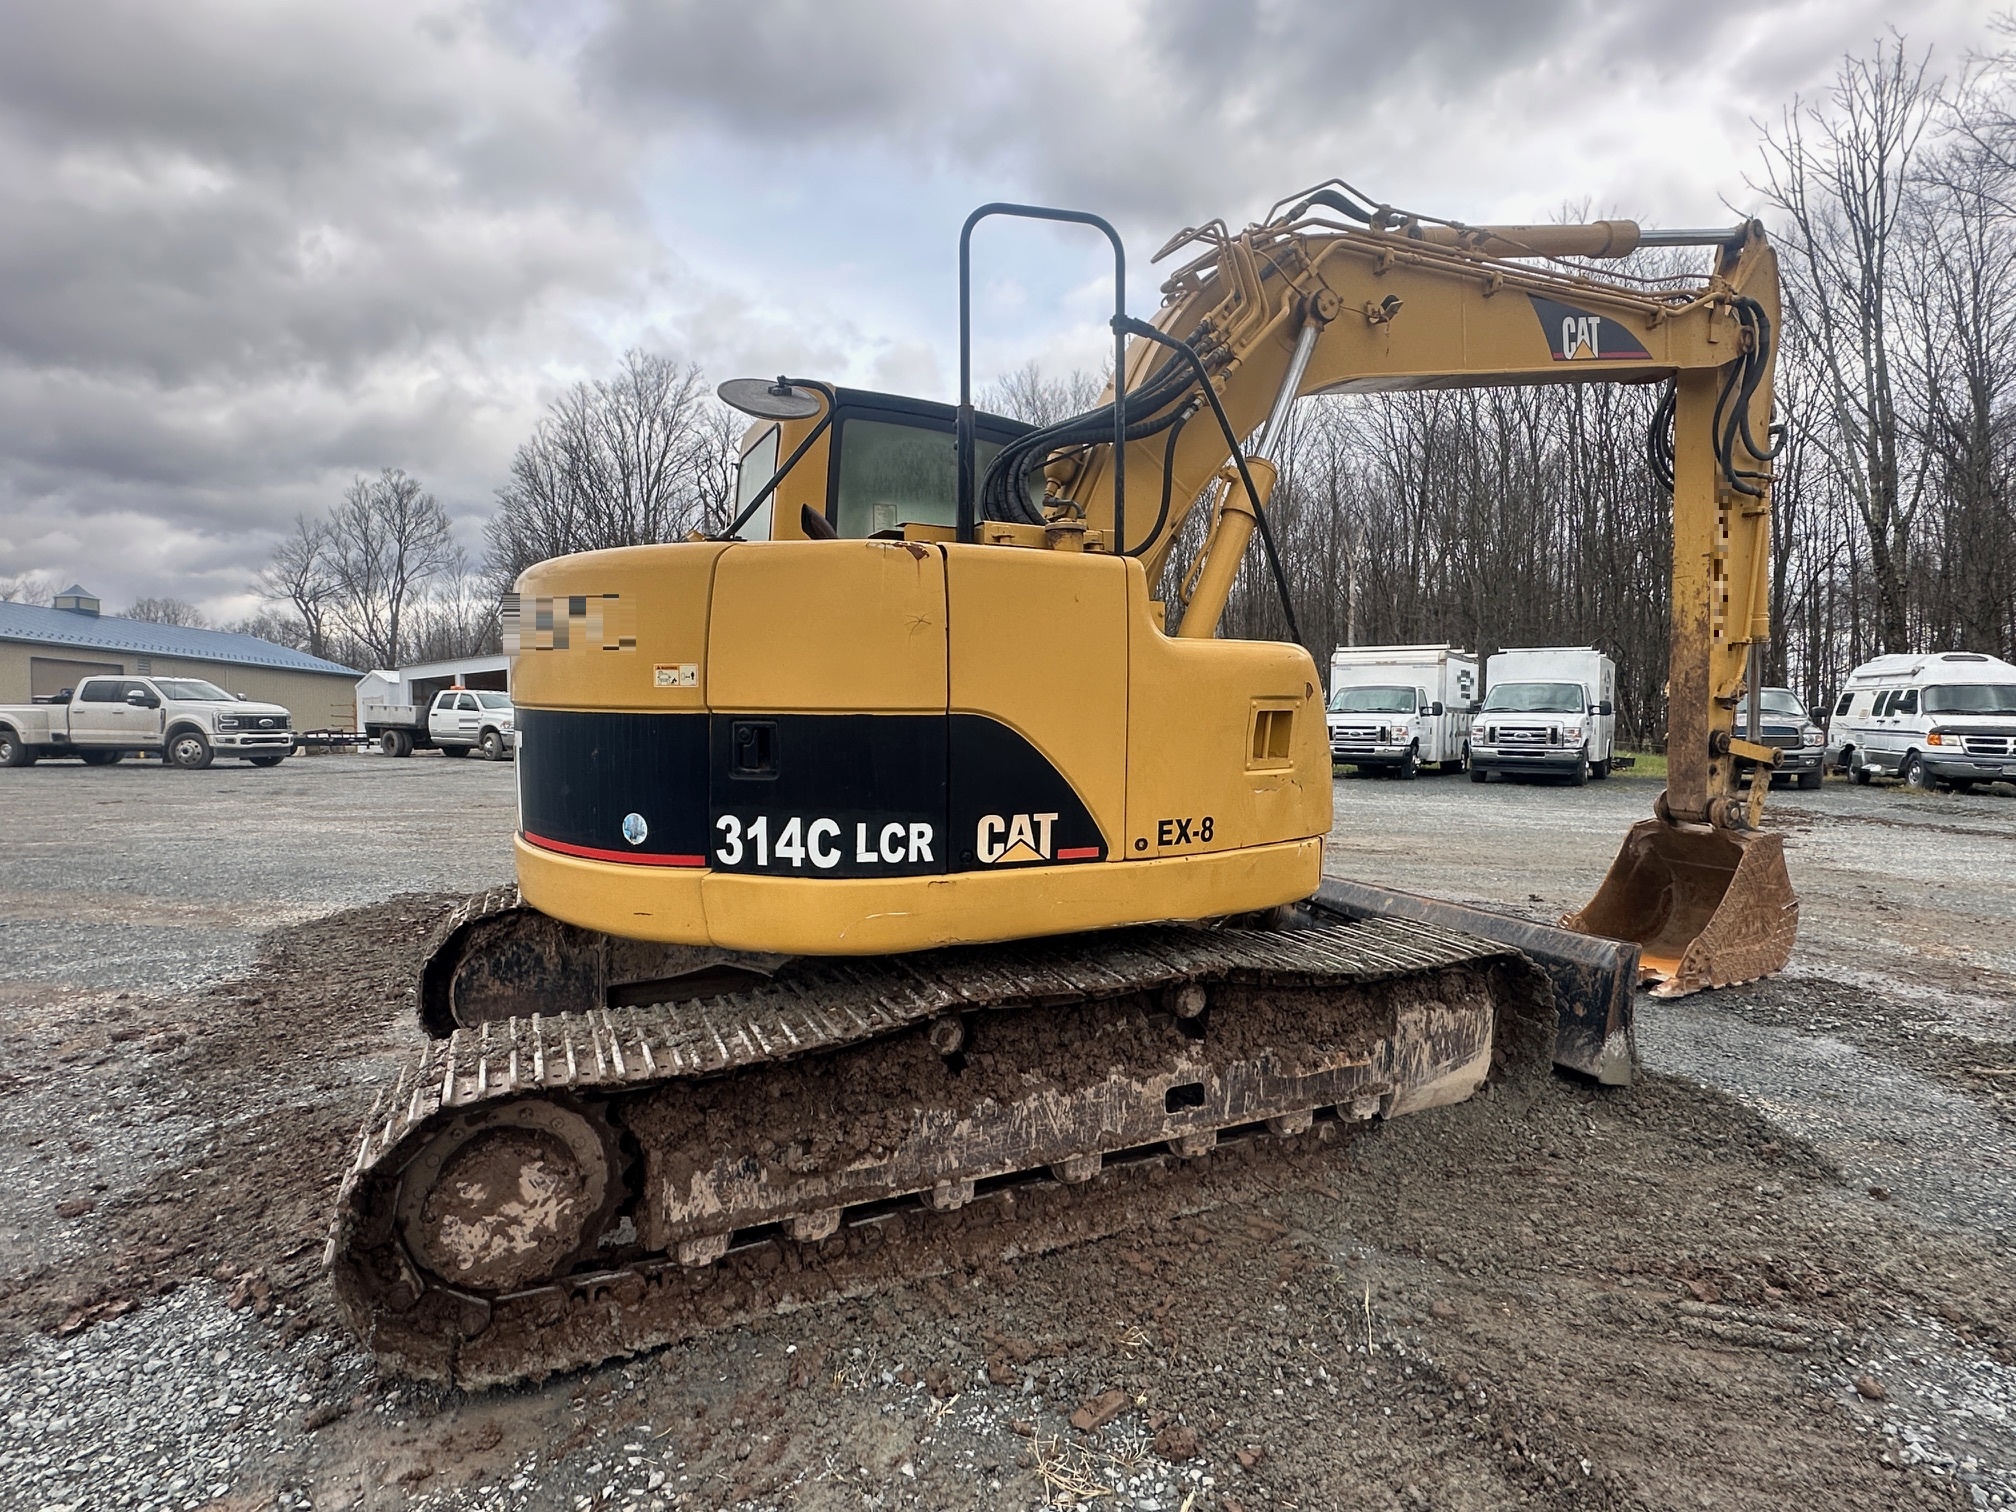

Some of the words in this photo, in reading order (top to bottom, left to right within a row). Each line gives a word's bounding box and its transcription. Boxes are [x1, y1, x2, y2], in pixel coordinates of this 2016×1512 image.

[1562, 316, 1600, 360] CAT
[716, 815, 841, 868] 314C
[856, 822, 934, 863] LCR
[977, 812, 1058, 863] CAT
[1157, 816, 1214, 846] EX-8
